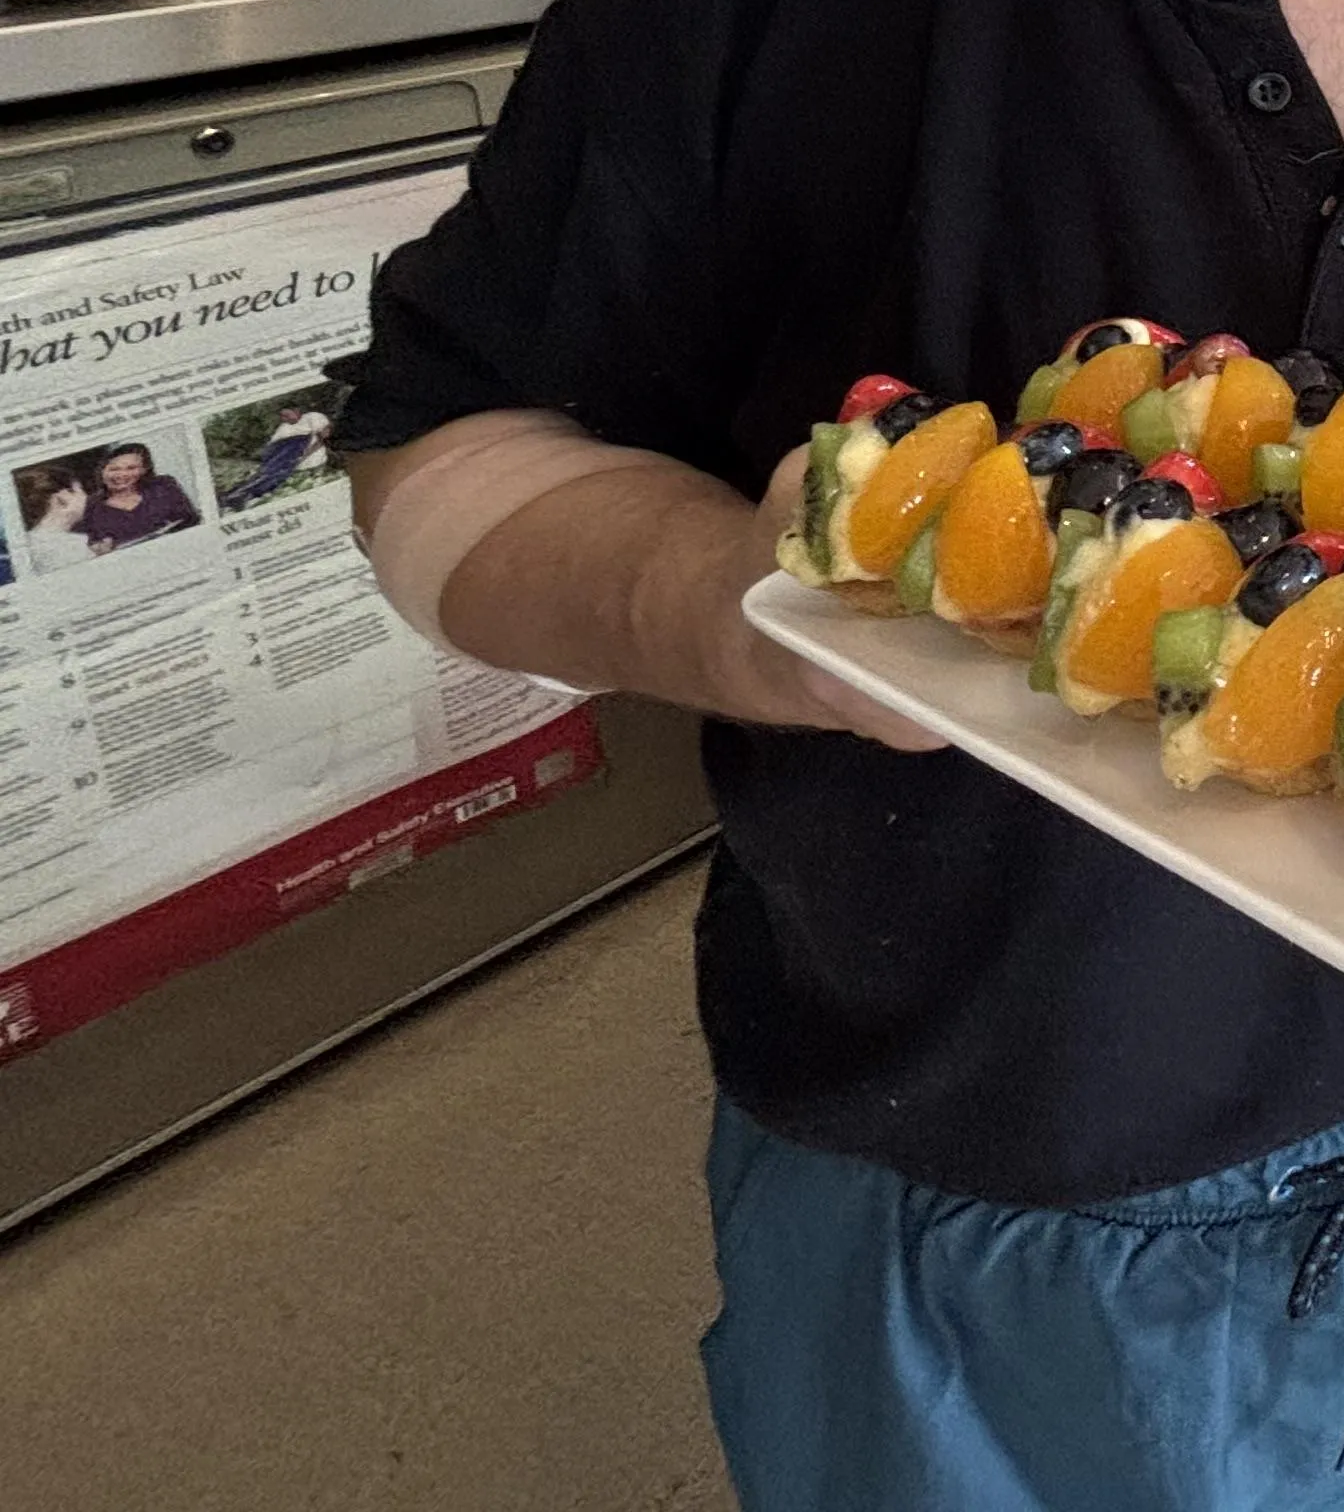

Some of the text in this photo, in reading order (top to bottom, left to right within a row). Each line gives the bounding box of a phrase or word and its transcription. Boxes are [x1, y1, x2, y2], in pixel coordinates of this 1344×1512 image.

[0, 269, 357, 375] hat you need to
[41, 296, 93, 327] and
[98, 281, 181, 310] Safety
[188, 266, 247, 291] Law
